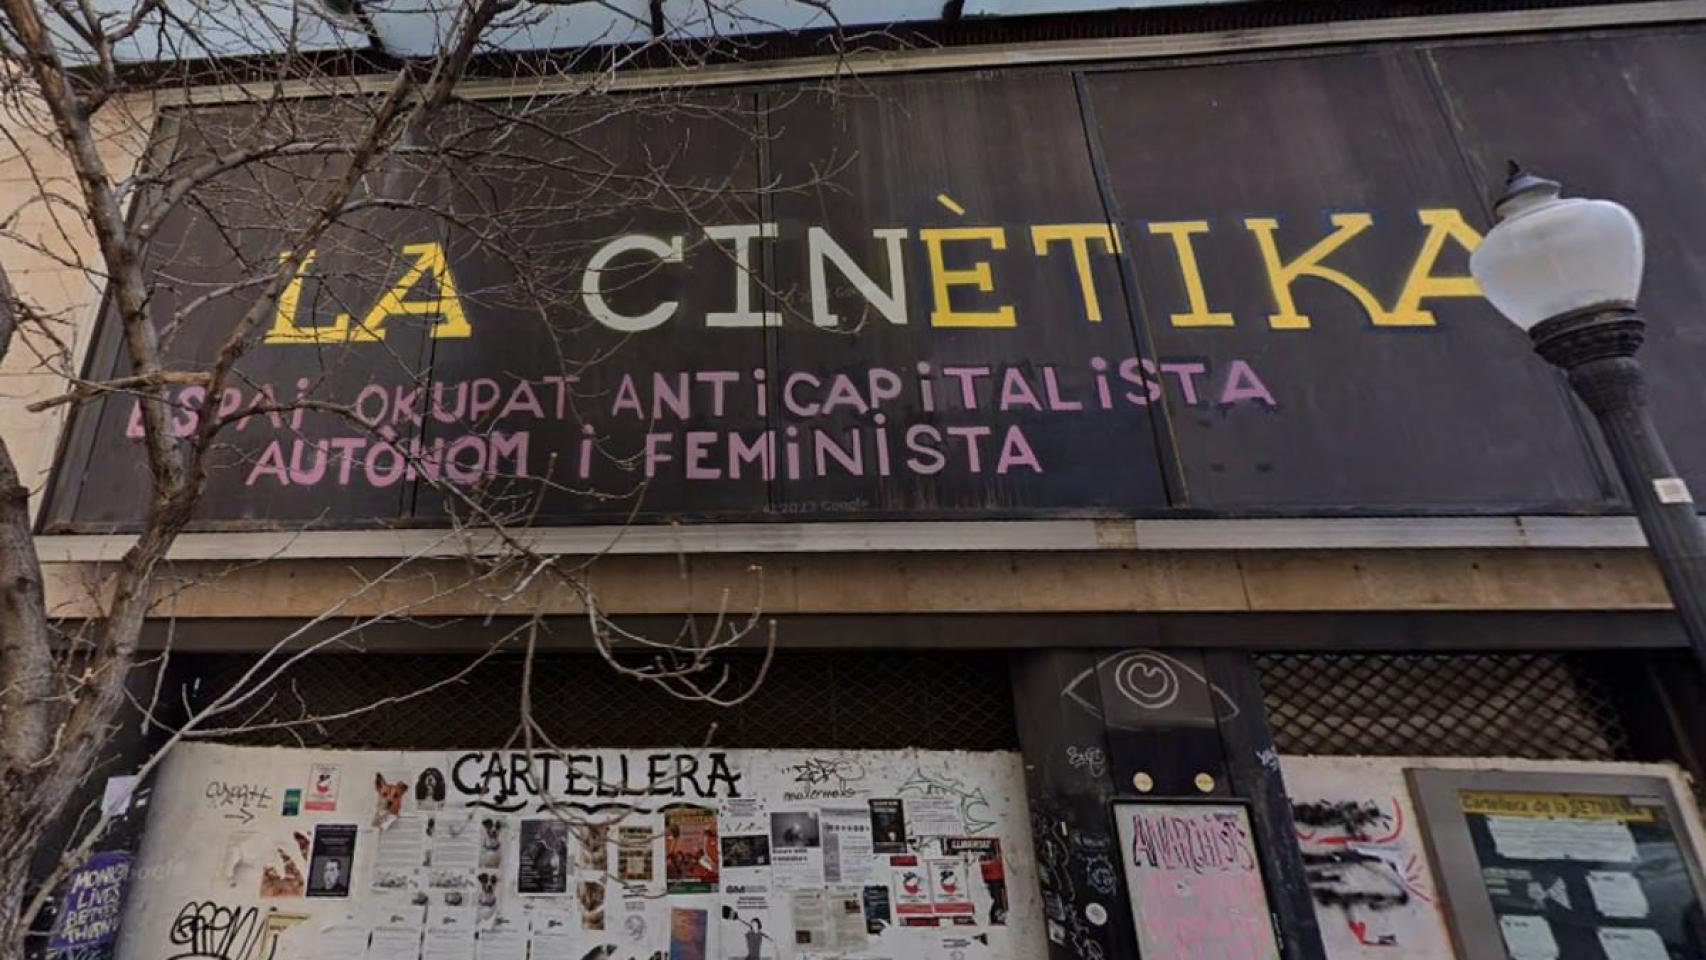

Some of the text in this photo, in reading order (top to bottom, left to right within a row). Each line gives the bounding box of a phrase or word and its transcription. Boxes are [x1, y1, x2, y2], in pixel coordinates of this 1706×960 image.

[263, 194, 1486, 344] LA CINÈTIKA
[356, 374, 580, 428] OKUPAT
[246, 423, 529, 488] AUTÒNOM
[452, 751, 742, 801] CARTELLERA
